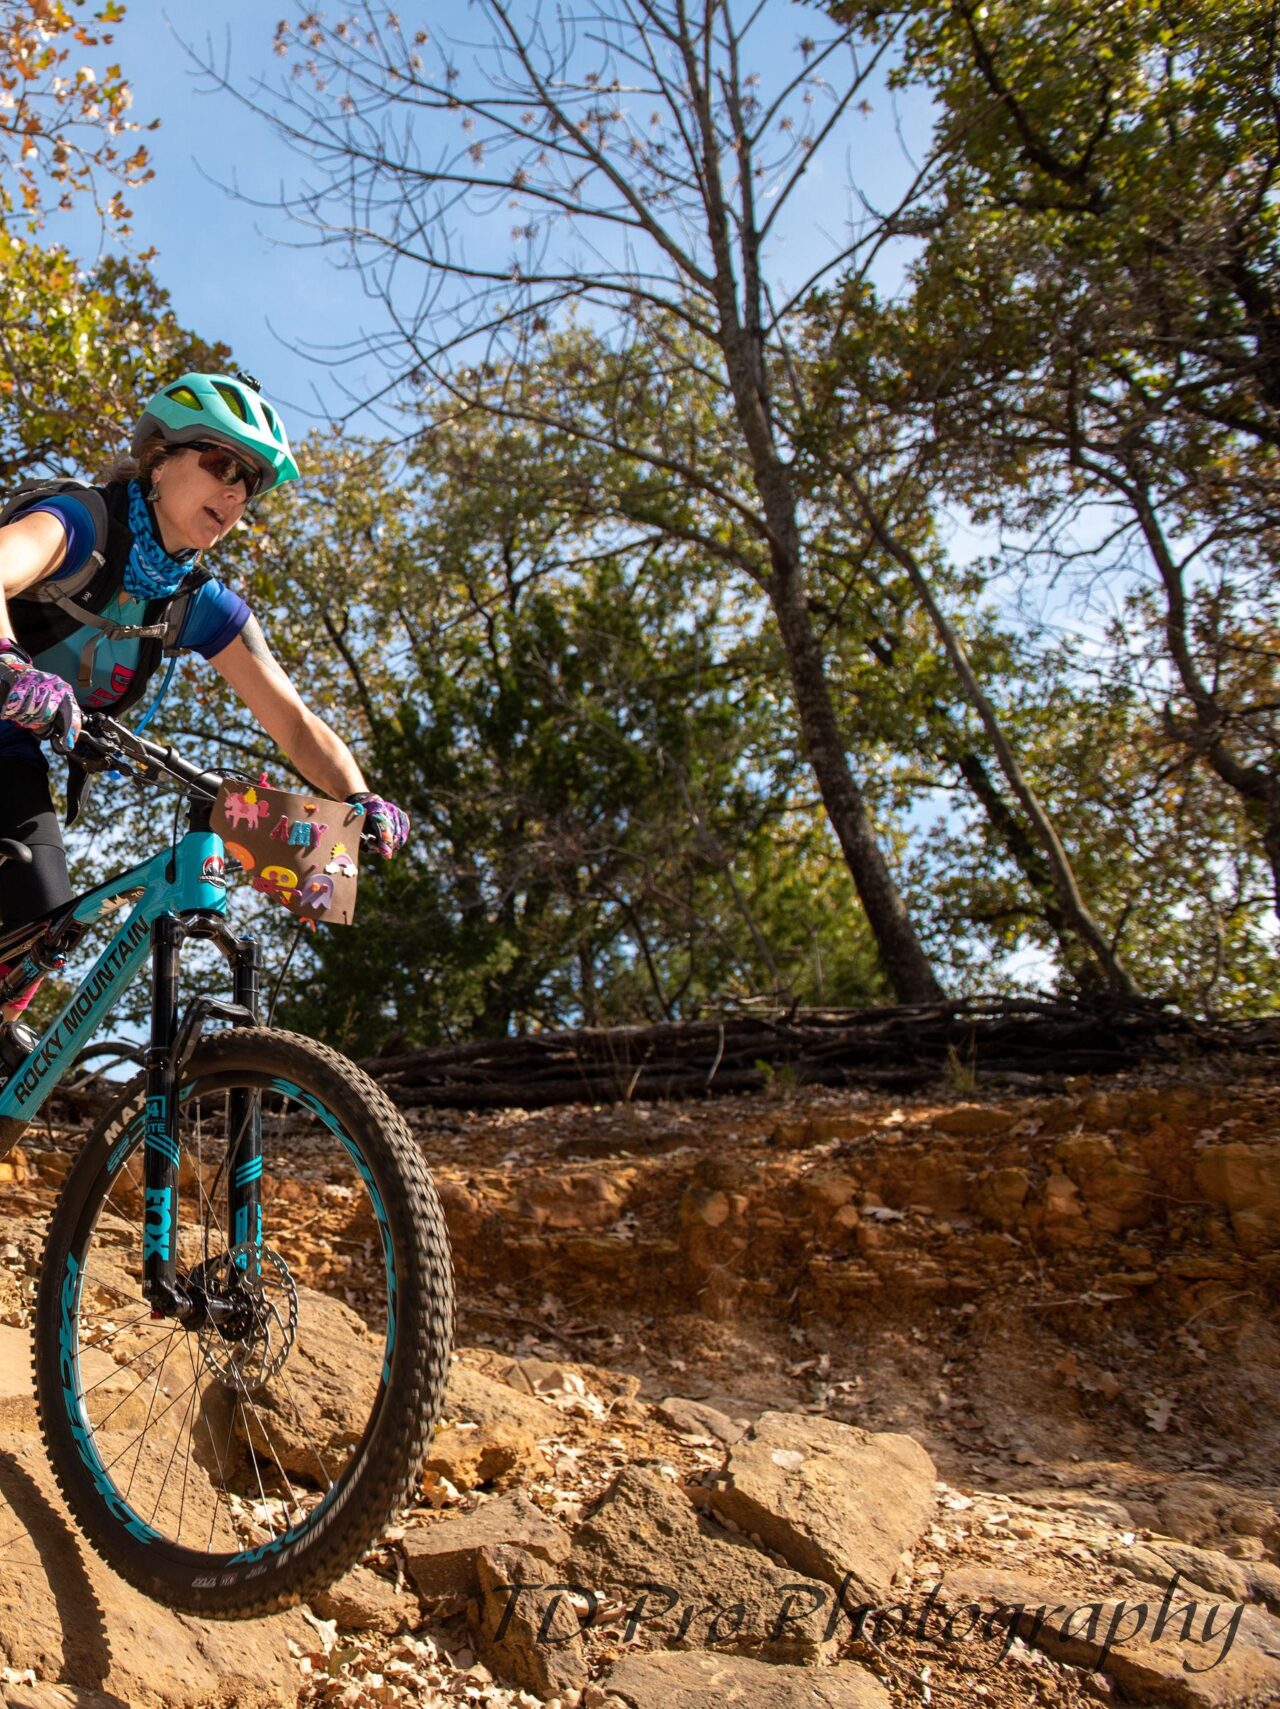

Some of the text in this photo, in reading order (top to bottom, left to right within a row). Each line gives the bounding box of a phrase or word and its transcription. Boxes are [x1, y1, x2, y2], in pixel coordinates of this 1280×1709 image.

[270, 815, 328, 848] AMY
[14, 915, 150, 1104] ROCKY MOUNTAIN
[103, 1089, 146, 1146] MAX
[144, 1187, 172, 1262] FOX
